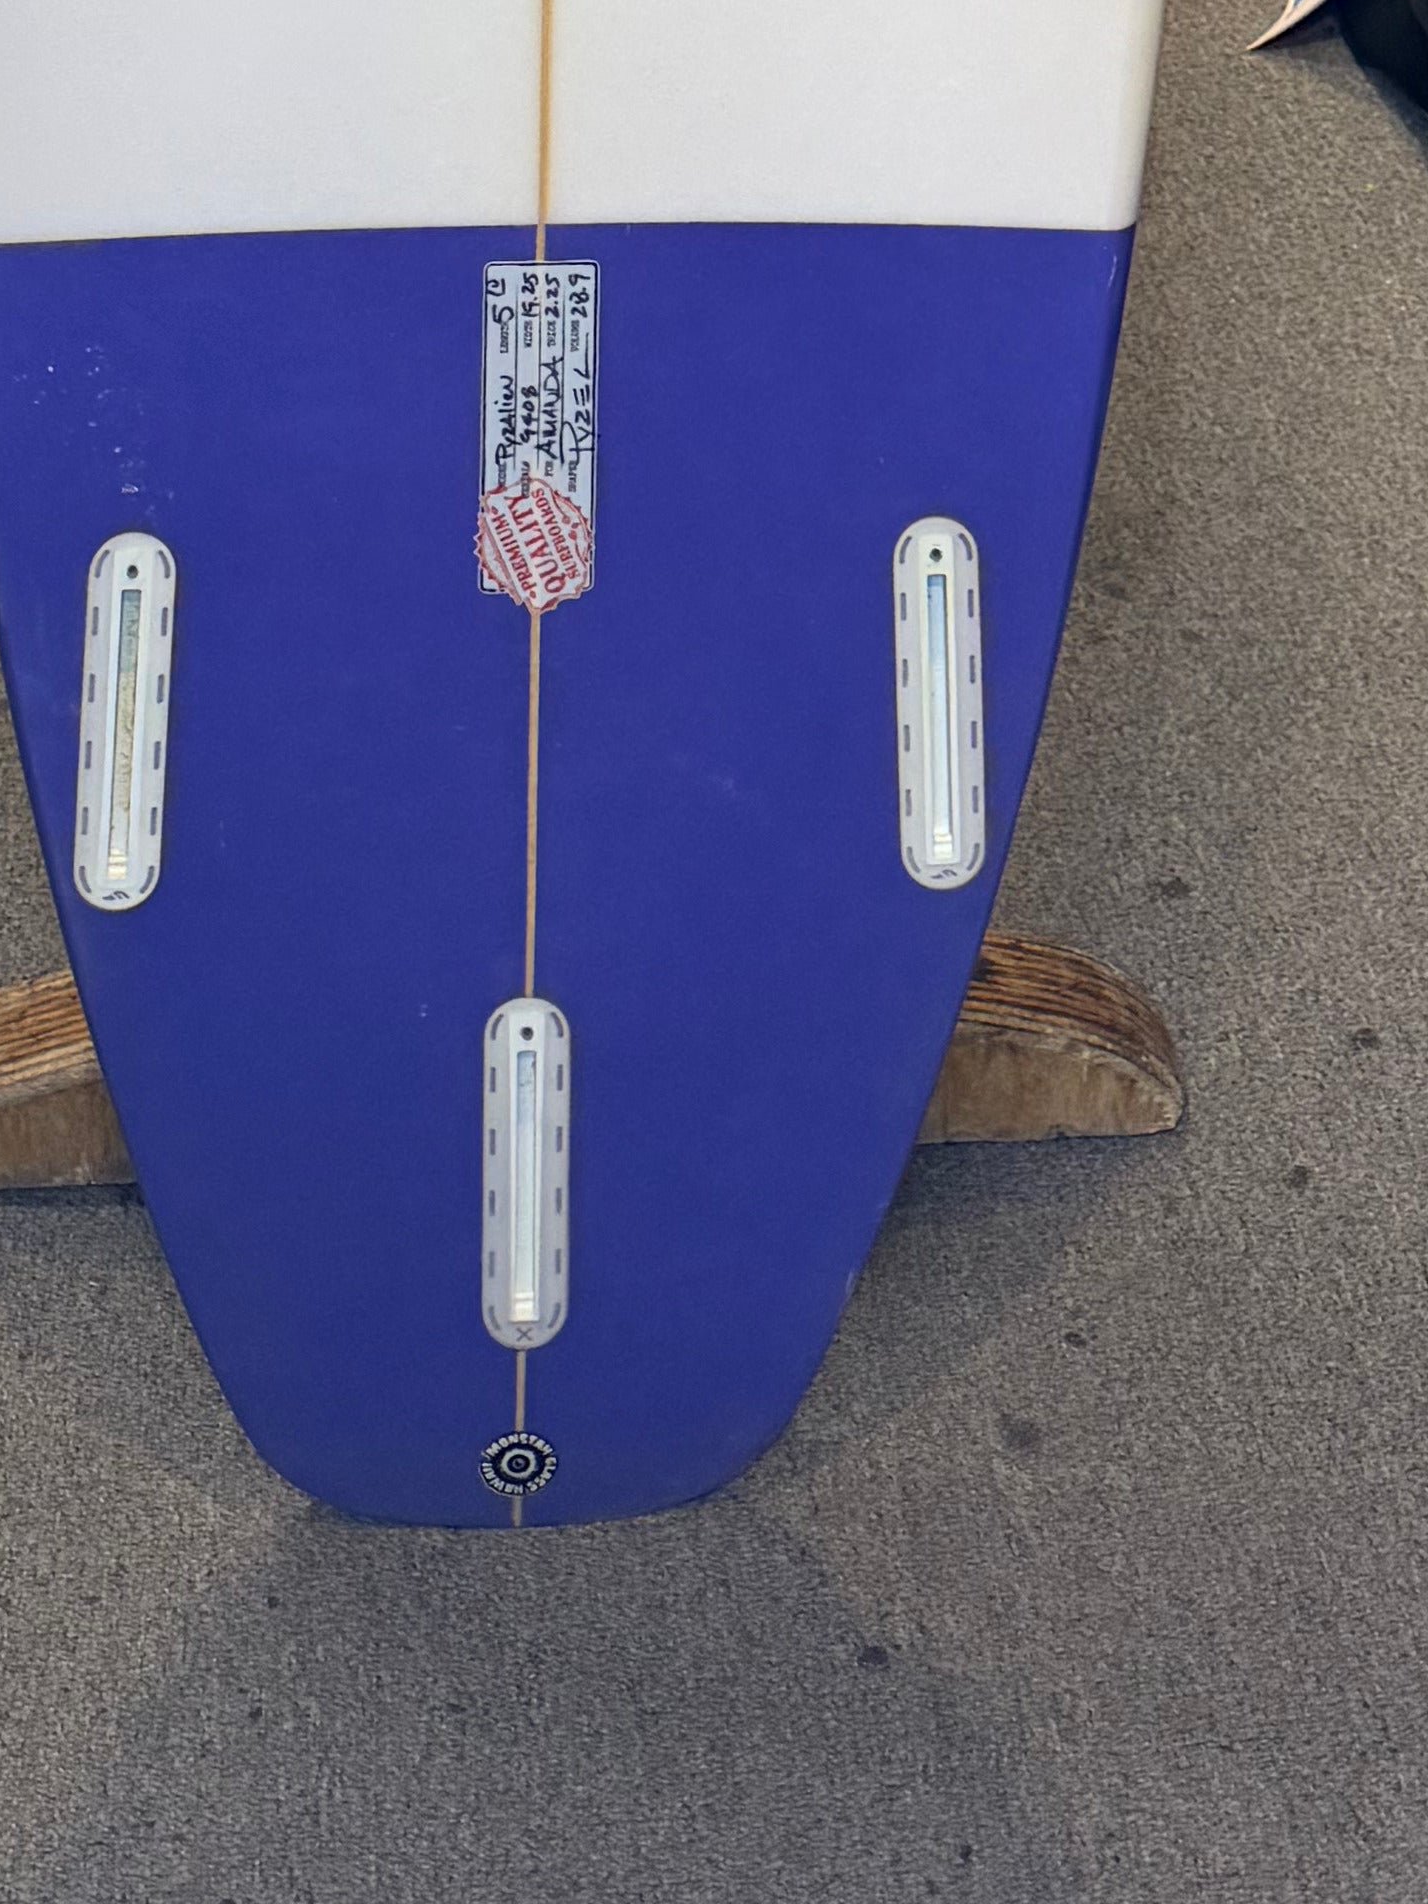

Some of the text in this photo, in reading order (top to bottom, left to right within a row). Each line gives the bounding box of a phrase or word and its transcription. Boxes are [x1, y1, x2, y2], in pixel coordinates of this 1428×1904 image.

[521, 273, 540, 317] 19.25
[544, 273, 560, 318] 2.25
[568, 274, 590, 318] 28.9
[499, 513, 533, 592] PREMIUM
[505, 493, 565, 595] QUALITY
[531, 486, 581, 580] SURFBOARDS
